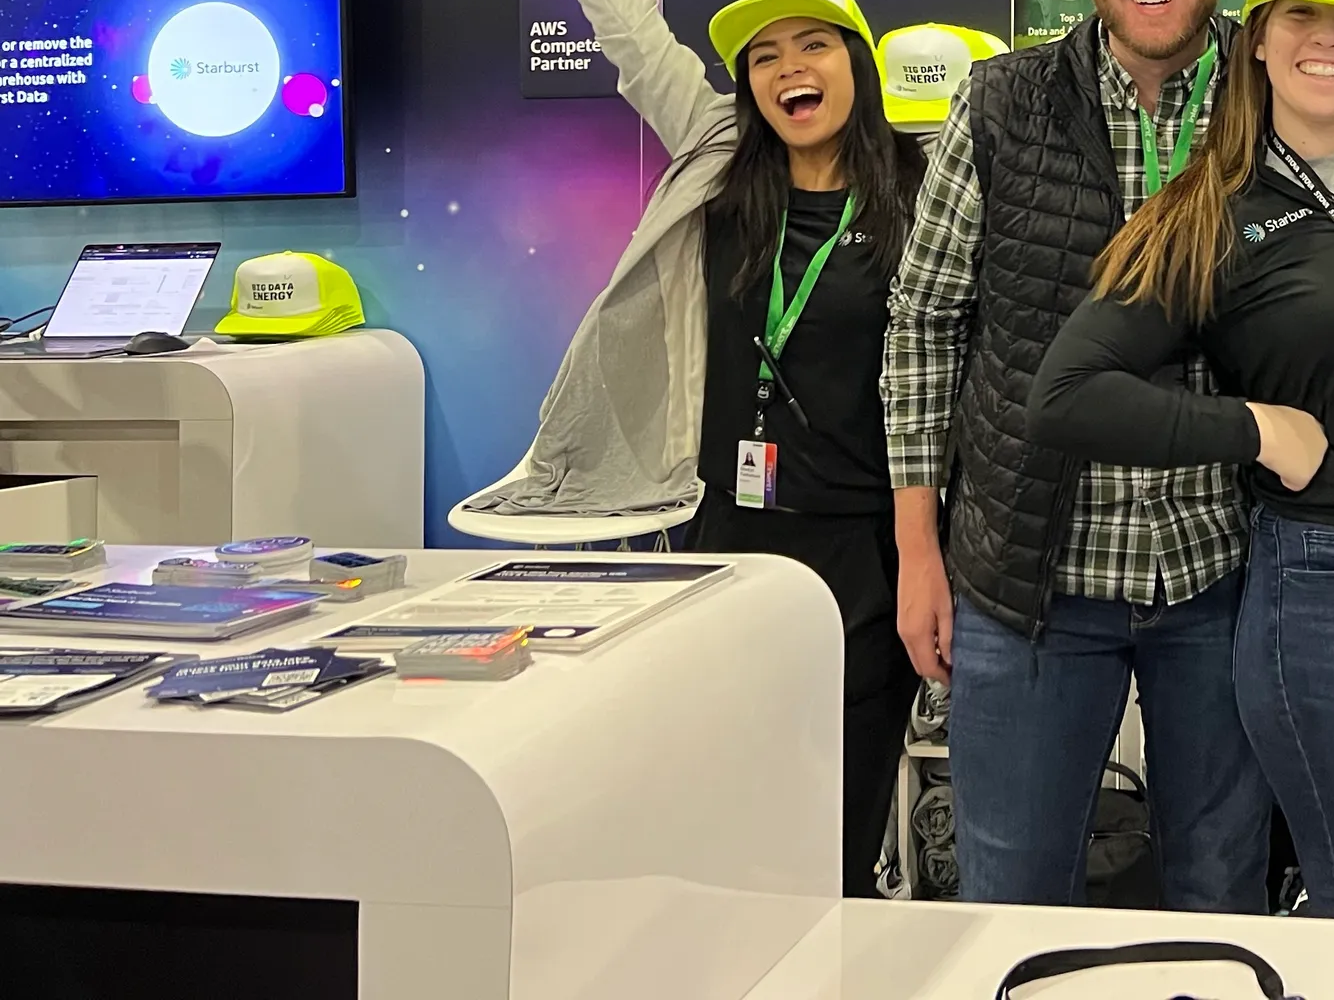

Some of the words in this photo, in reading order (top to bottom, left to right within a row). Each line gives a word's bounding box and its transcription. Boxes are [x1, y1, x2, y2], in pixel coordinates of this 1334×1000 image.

[1060, 13, 1073, 24] Top
[1077, 13, 1083, 21] 3
[1222, 9, 1241, 17] Best
[530, 21, 568, 37] AWS
[1028, 27, 1048, 36] Data
[1049, 26, 1065, 35] and
[1, 40, 17, 52] or
[19, 40, 68, 52] remove
[69, 36, 93, 49] the
[0, 58, 8, 69] r
[9, 58, 18, 69] a
[20, 53, 93, 69] centralized
[530, 57, 592, 71] Partner
[196, 61, 260, 74] Starburst
[902, 65, 919, 73] BIG
[920, 64, 947, 73] DATA
[56, 70, 86, 84] with
[904, 73, 947, 83] ENERGY
[16, 90, 48, 103] Data
[252, 283, 266, 291] BIG
[268, 283, 294, 291] DATA
[253, 291, 294, 301] ENERGY
